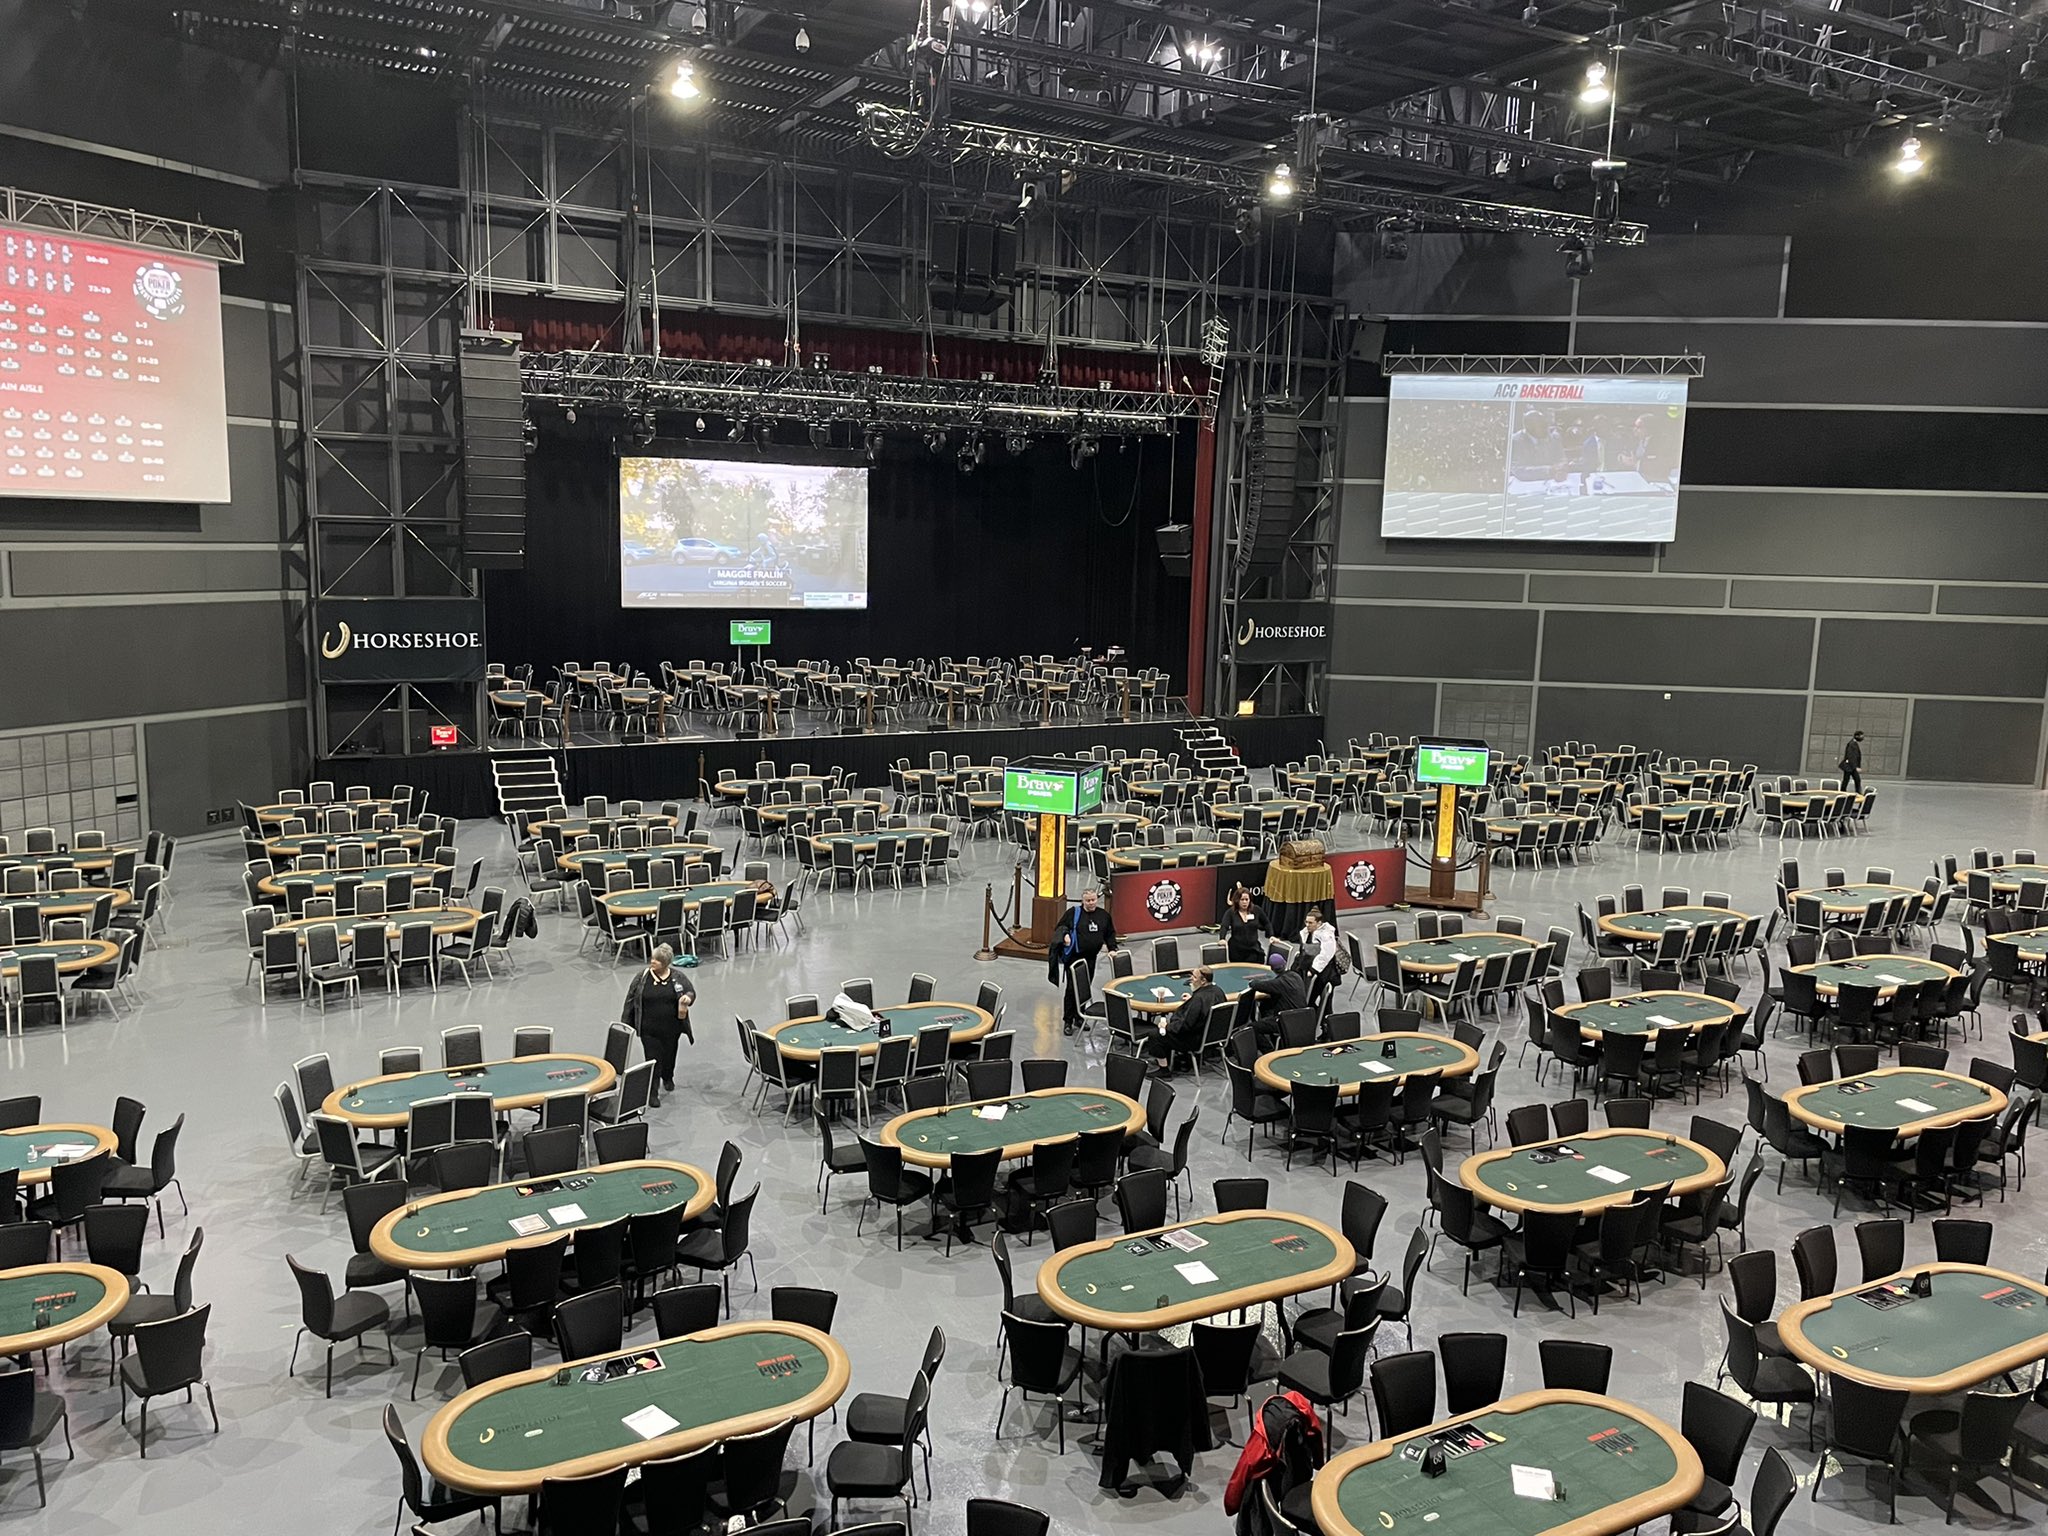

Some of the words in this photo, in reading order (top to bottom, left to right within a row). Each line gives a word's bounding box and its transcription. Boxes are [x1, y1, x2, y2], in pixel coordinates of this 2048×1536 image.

[0, 382, 18, 391] AIN
[1494, 384, 1518, 398] ACC
[1519, 384, 1585, 399] BASKETBALL
[717, 570, 752, 578] MAGGIE
[753, 571, 784, 579] FRALIN
[1255, 626, 1326, 638] HORSESHOE
[353, 632, 480, 649] HORSESHOE
[759, 1359, 803, 1376] POKER
[1432, 1451, 1443, 1465] 68
